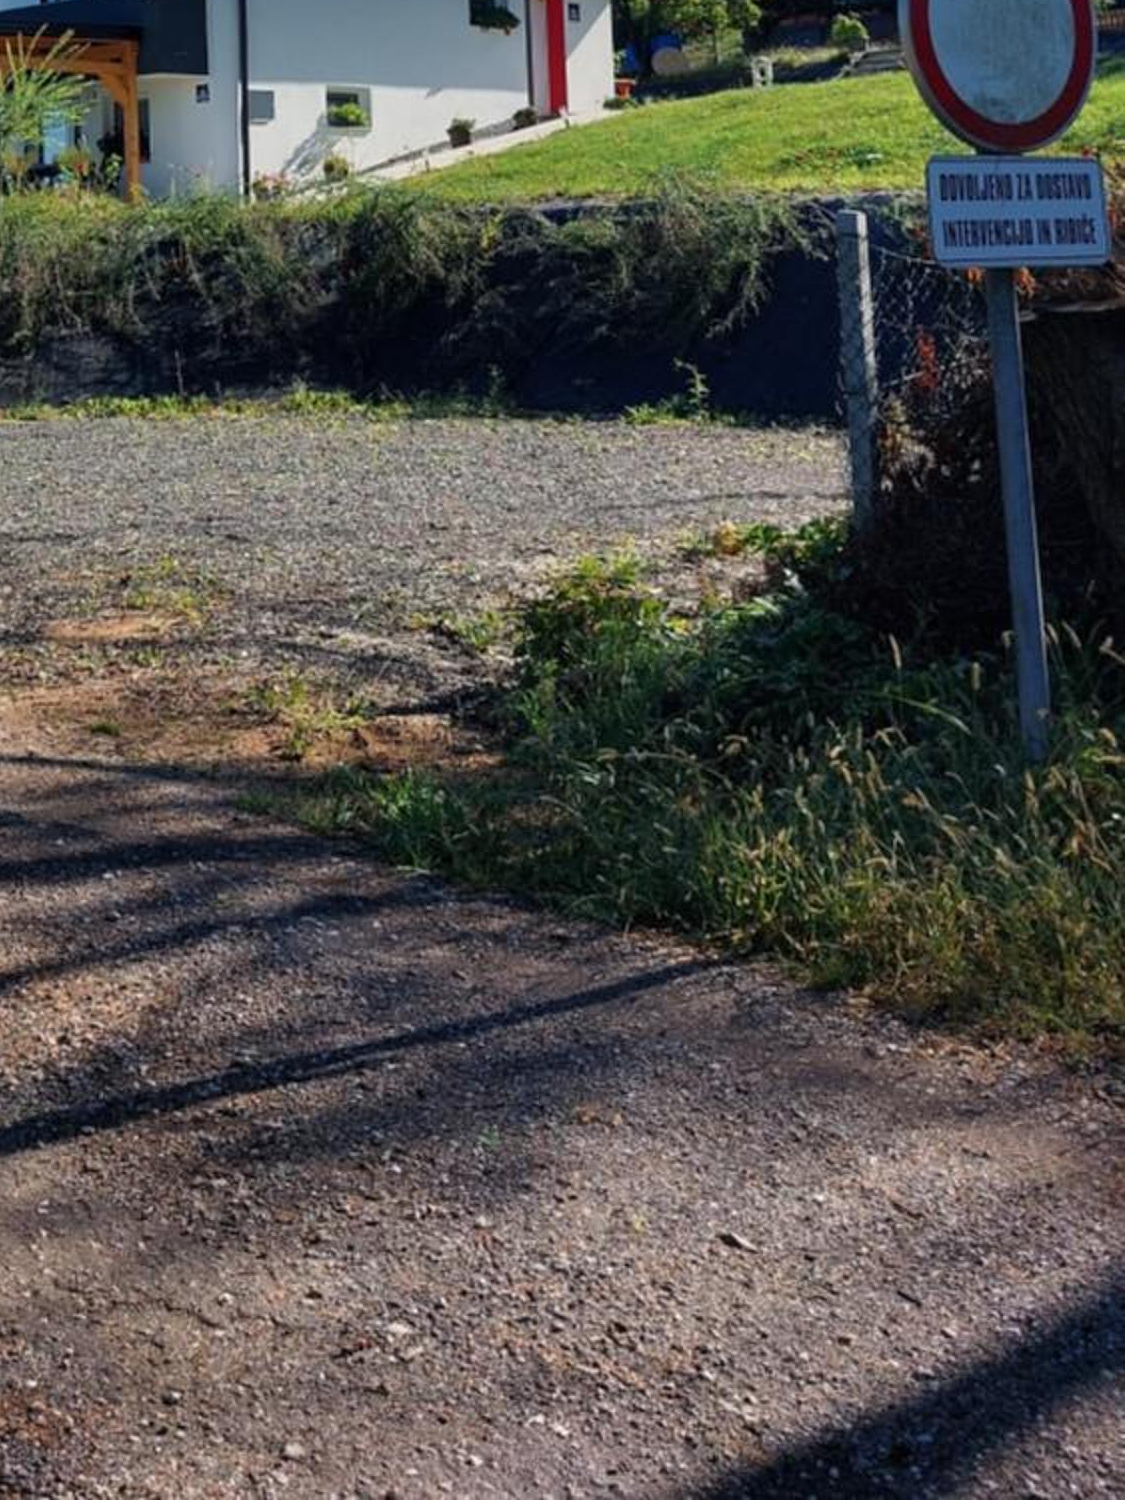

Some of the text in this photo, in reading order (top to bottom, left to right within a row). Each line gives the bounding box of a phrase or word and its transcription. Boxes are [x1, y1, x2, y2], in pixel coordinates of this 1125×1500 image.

[940, 174, 1092, 201] DOVOLJENO ZA DOSTAVO
[943, 219, 1034, 246] INTERVENCIJO
[1036, 218, 1052, 245] IN
